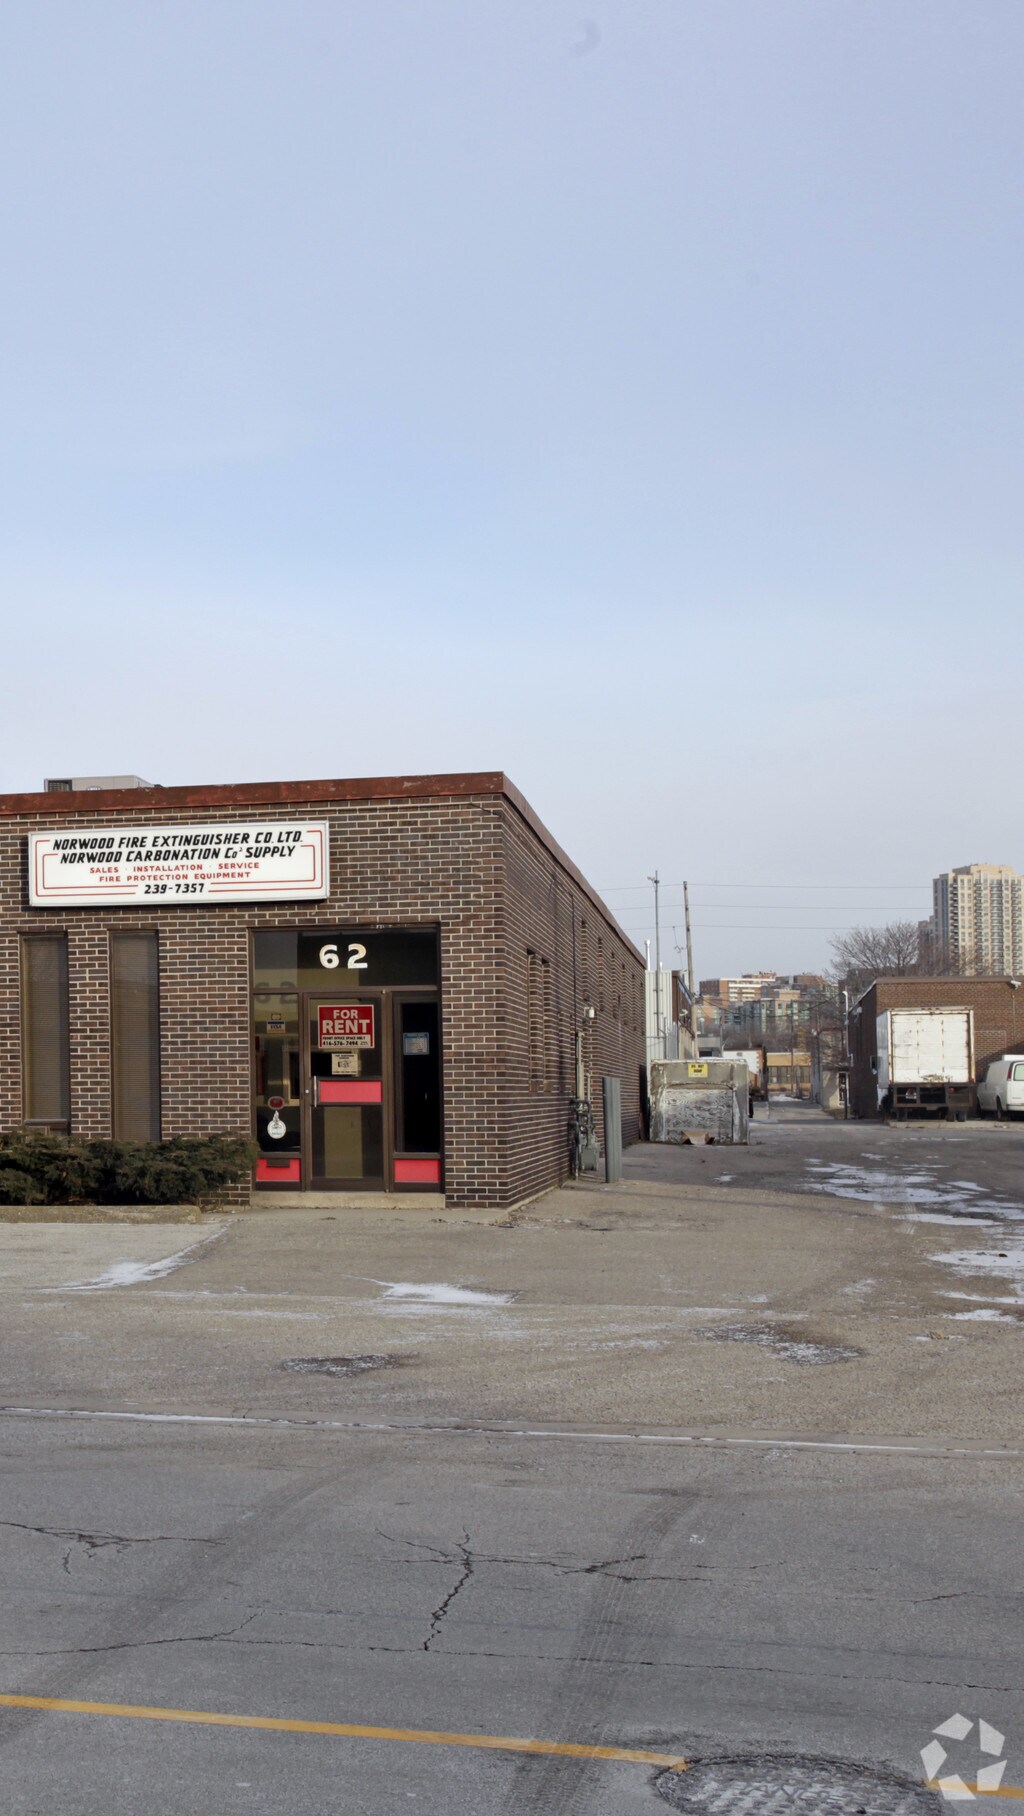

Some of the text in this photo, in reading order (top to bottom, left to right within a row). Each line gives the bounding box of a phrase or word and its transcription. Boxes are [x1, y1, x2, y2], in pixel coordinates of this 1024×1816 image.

[53, 837, 115, 850] NORWOOD
[118, 836, 147, 848] FIRE
[152, 832, 250, 847] EXTINGUISHER
[60, 851, 123, 864] NORWOOD
[126, 848, 220, 862] CARBONATION
[245, 845, 295, 858] SUPPLY
[90, 862, 260, 874] SALES INSTALLATION SERVICE
[194, 871, 251, 880] EQUIPMENT
[144, 883, 205, 894] 239-7357
[319, 943, 369, 969] 62
[333, 1009, 359, 1019] FOR
[322, 1019, 371, 1034] RENT
